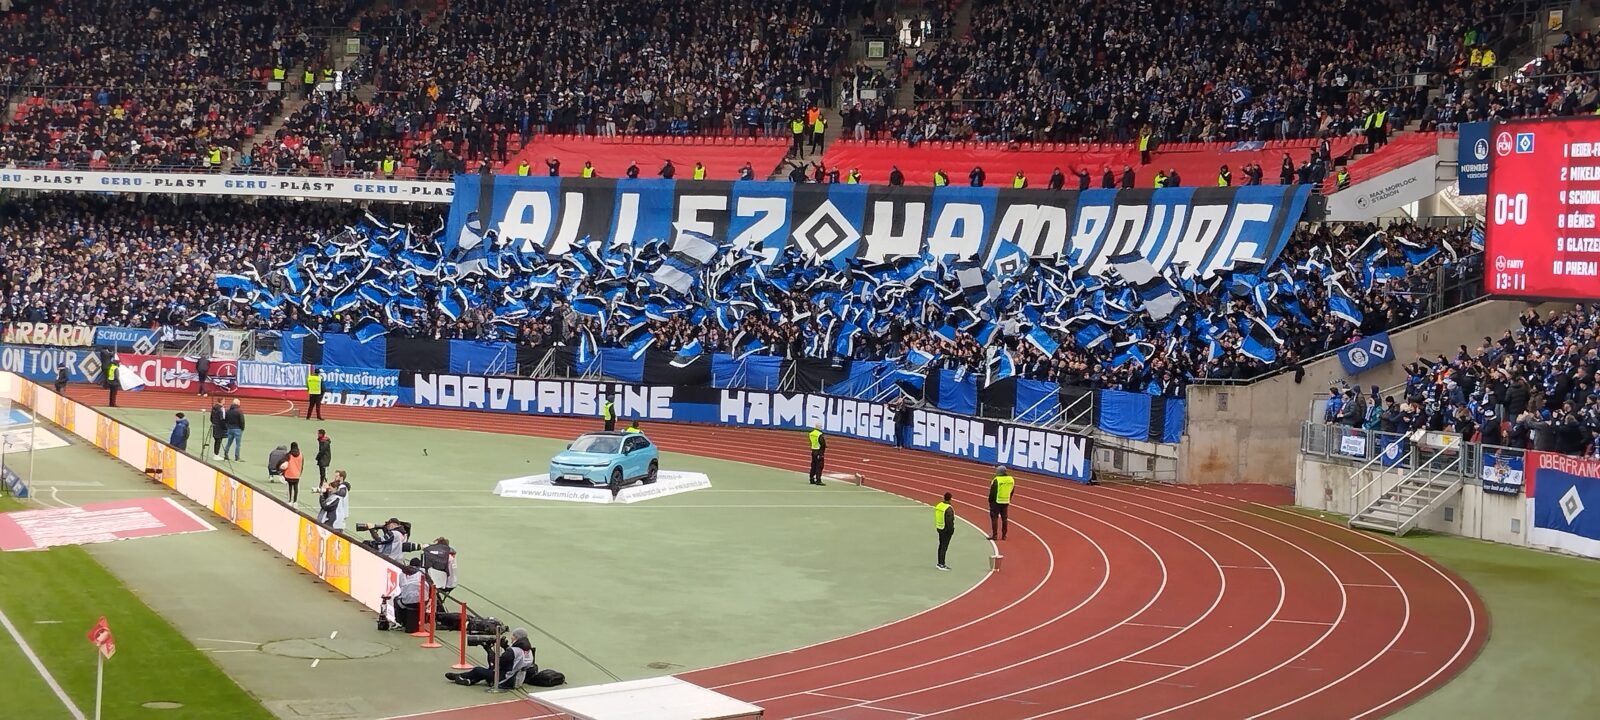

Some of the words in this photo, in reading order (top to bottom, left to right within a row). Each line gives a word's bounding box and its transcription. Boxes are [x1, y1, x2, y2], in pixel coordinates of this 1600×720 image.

[1385, 175, 1418, 192] MORLOCK
[1560, 167, 1567, 181] 2
[1494, 193, 1528, 225] 0:0
[498, 191, 787, 265] ALLEZ
[865, 201, 1274, 280] HAMBURG
[1557, 237, 1564, 252] 9
[1553, 260, 1563, 275] 10
[1565, 261, 1598, 276] PHERAI
[1496, 273, 1526, 290] 13:11
[97, 329, 138, 342] SCHOLLI
[2, 348, 25, 373] ON
[29, 350, 77, 375] TOUR
[242, 363, 307, 386] NORDHAUSEN
[414, 373, 674, 419] NORDTRIBÜNE
[720, 389, 896, 442] HAMBURGER
[913, 410, 1086, 478] SPORT-VEREIN
